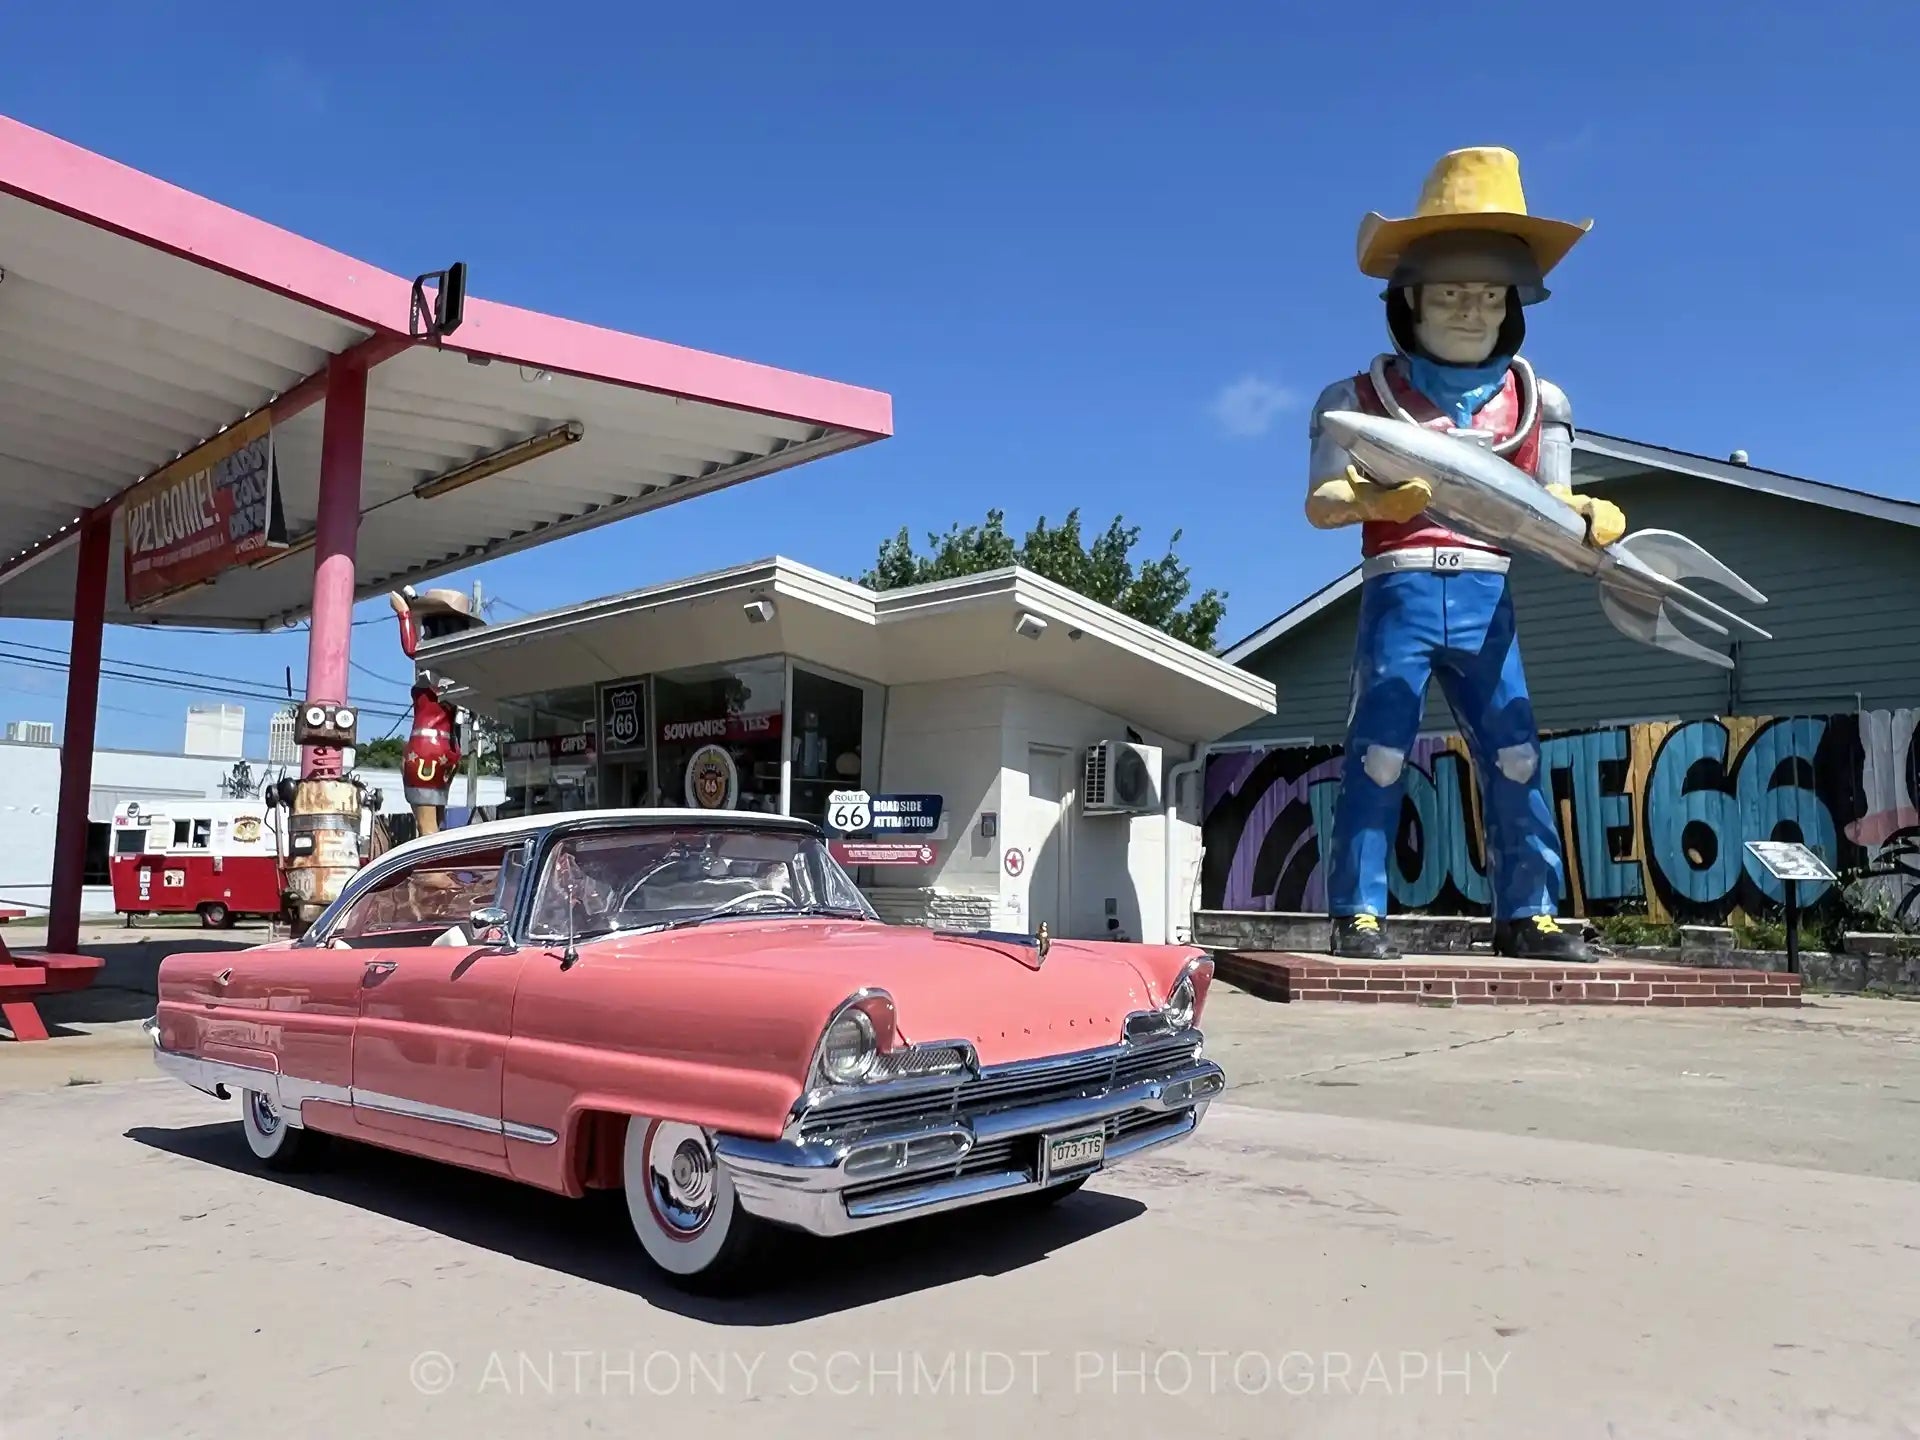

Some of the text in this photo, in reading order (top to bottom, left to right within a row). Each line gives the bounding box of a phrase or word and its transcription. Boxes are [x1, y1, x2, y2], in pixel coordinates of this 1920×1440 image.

[128, 467, 220, 554] WELCOME!
[1437, 553, 1460, 567] 66
[615, 713, 634, 736] 66
[664, 716, 770, 740] SOUVENIRS TEES
[561, 735, 587, 752] GIFTS
[705, 780, 717, 793] 66
[834, 794, 864, 802] ROUTE
[873, 801, 922, 812] ROADSIDE
[834, 805, 864, 827] 66
[873, 816, 934, 828] ATTRACTION
[1646, 719, 1838, 908] 66
